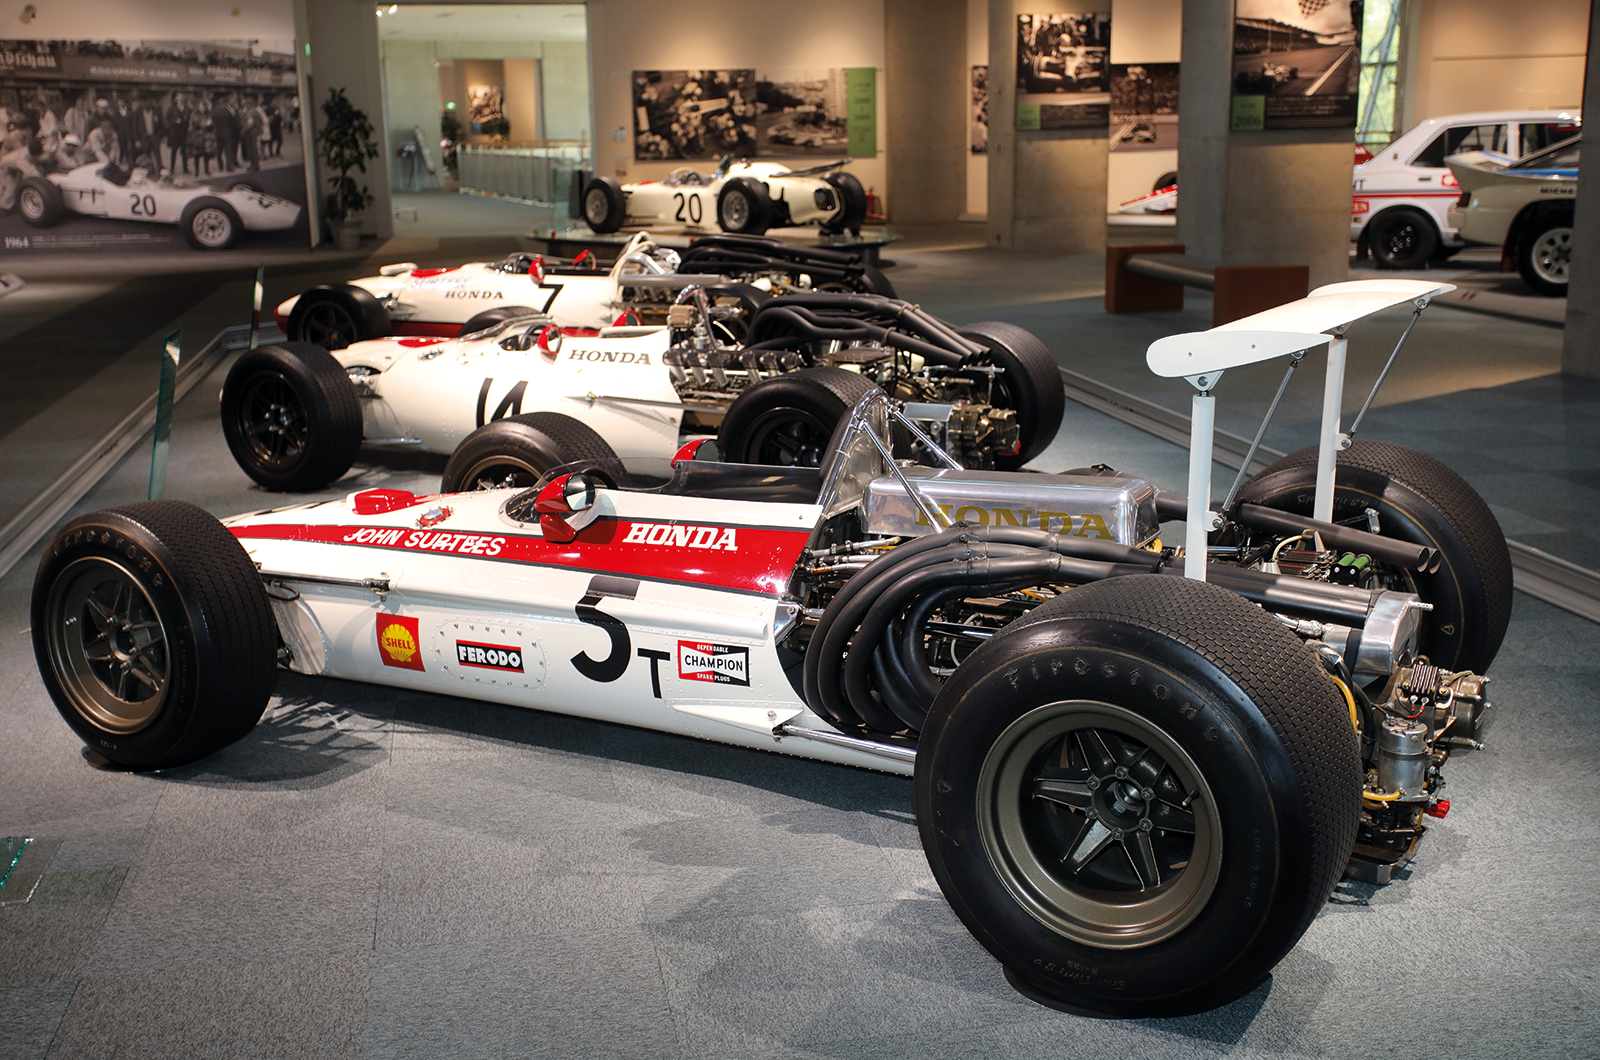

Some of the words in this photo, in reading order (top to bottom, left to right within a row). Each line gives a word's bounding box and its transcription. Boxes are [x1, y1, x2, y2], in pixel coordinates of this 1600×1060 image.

[129, 193, 157, 216] 20
[673, 192, 703, 224] 20
[4, 236, 30, 249] 1964
[444, 290, 505, 300] HONDA
[537, 283, 565, 314] 7
[568, 349, 652, 366] HONDA
[476, 377, 529, 430] 14
[915, 502, 1117, 541] HONDA
[343, 528, 405, 546] JOHN
[404, 530, 506, 556] SURTEES
[622, 522, 739, 551] HONDA
[386, 637, 413, 650] SHELL
[570, 575, 642, 683] 5
[637, 647, 671, 699] T
[697, 644, 729, 653] DEPENDABLE
[458, 645, 521, 668] FERODO
[684, 654, 743, 672] CHAMPION
